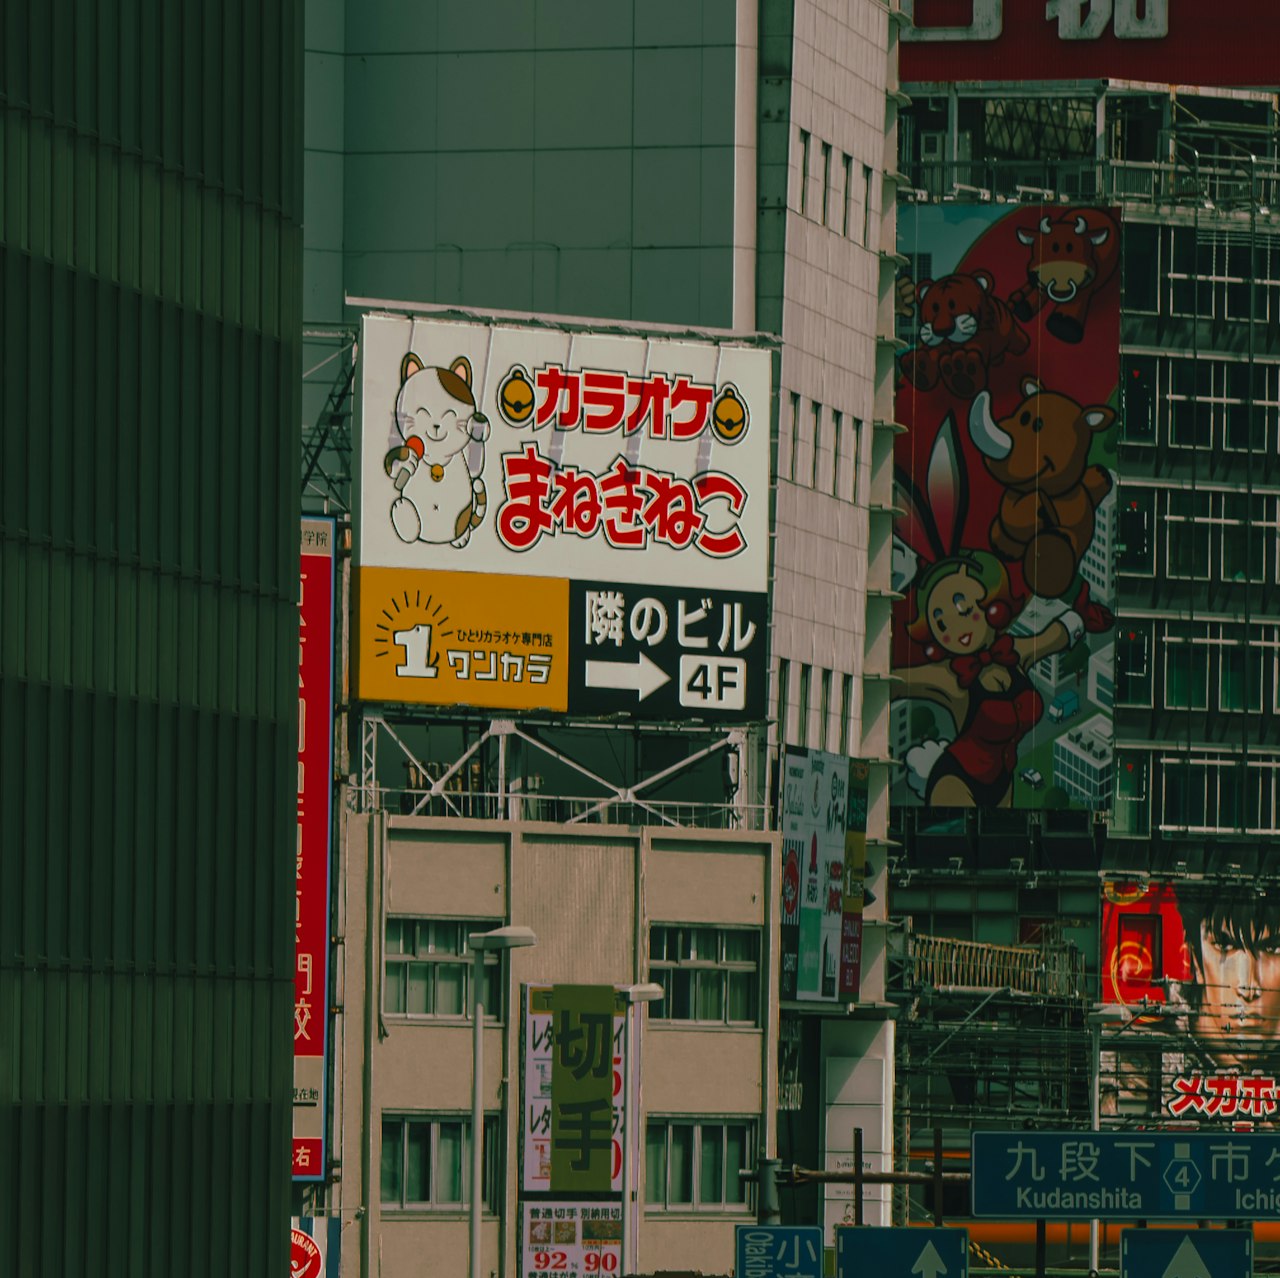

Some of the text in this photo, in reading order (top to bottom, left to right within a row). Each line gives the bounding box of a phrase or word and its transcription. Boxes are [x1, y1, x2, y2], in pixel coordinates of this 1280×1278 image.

[535, 367, 714, 437] カラオケ
[500, 446, 745, 553] まねきねこ
[456, 628, 554, 649] ひとりカラオケ専門店
[585, 590, 758, 652] 隣のビル
[446, 649, 553, 685] ワンカラ
[685, 665, 741, 702] 4F
[556, 1009, 614, 1172] 切手
[1006, 1140, 1158, 1184] 九段下
[1016, 1185, 1143, 1211] Kudanshita
[534, 1251, 568, 1270] 92
[584, 1252, 618, 1272] 90
